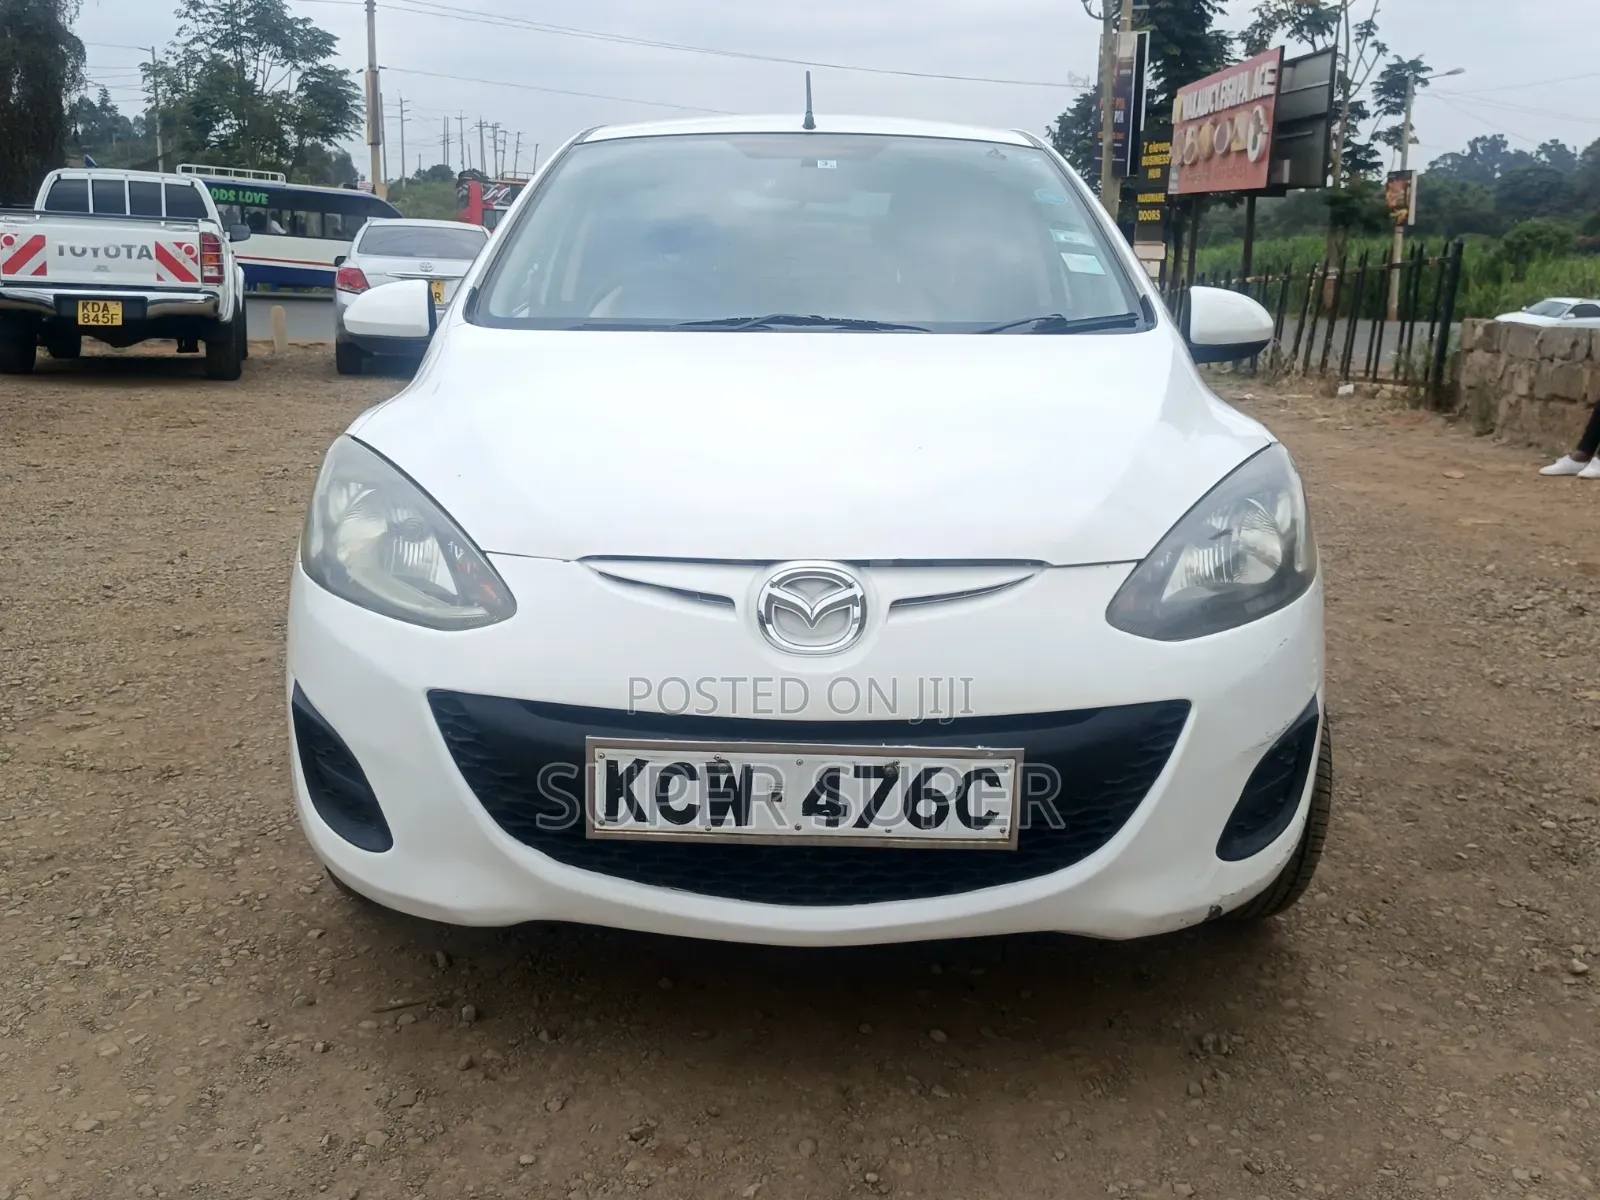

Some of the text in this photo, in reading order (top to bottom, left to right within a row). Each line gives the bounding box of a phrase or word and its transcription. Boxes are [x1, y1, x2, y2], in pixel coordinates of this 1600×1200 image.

[1143, 142, 1148, 154] 7
[1141, 154, 1170, 166] BUSINESS
[211, 187, 269, 205] ODS LOVE
[1137, 193, 1165, 203] HARDWARE
[1138, 210, 1161, 221] DOORS
[58, 244, 153, 260] TOYOTA
[81, 302, 110, 313] KDA
[81, 313, 119, 324] 845F
[602, 758, 1003, 831] KCW 476C
